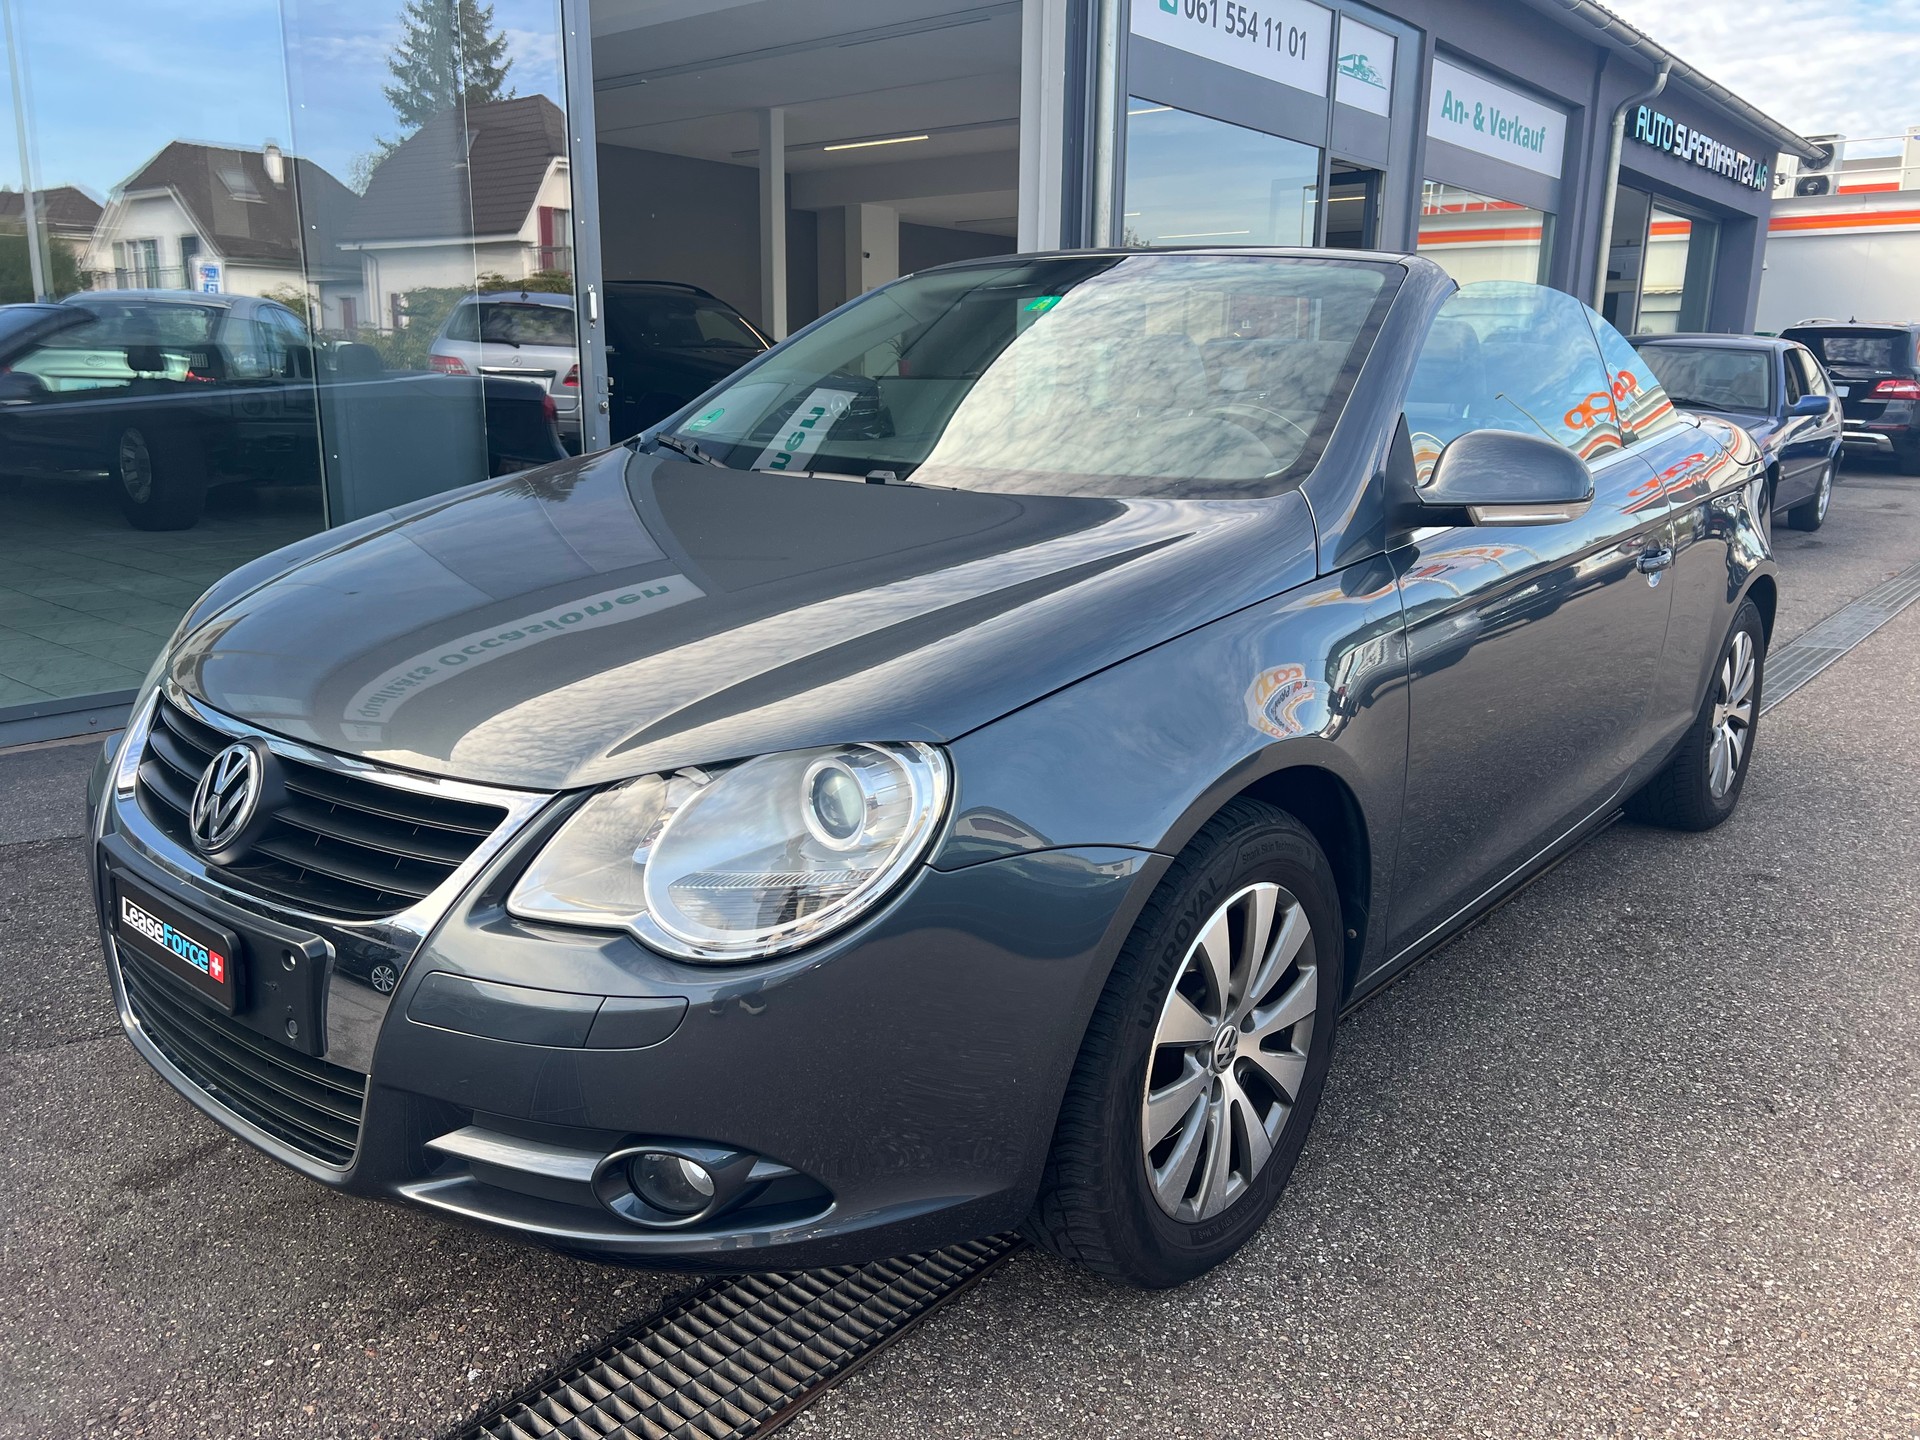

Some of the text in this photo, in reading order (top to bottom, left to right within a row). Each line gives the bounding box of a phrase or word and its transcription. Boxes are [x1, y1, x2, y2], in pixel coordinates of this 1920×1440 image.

[1184, 0, 1307, 60] 061 554 11 01
[1441, 89, 1547, 153] An- & Verkauf
[1635, 105, 1674, 151] AUTO
[1753, 162, 1768, 192] AG
[1242, 846, 1261, 865] Shark
[122, 896, 209, 971] LeaseForce
[1137, 877, 1223, 1030] UNIROYAL
